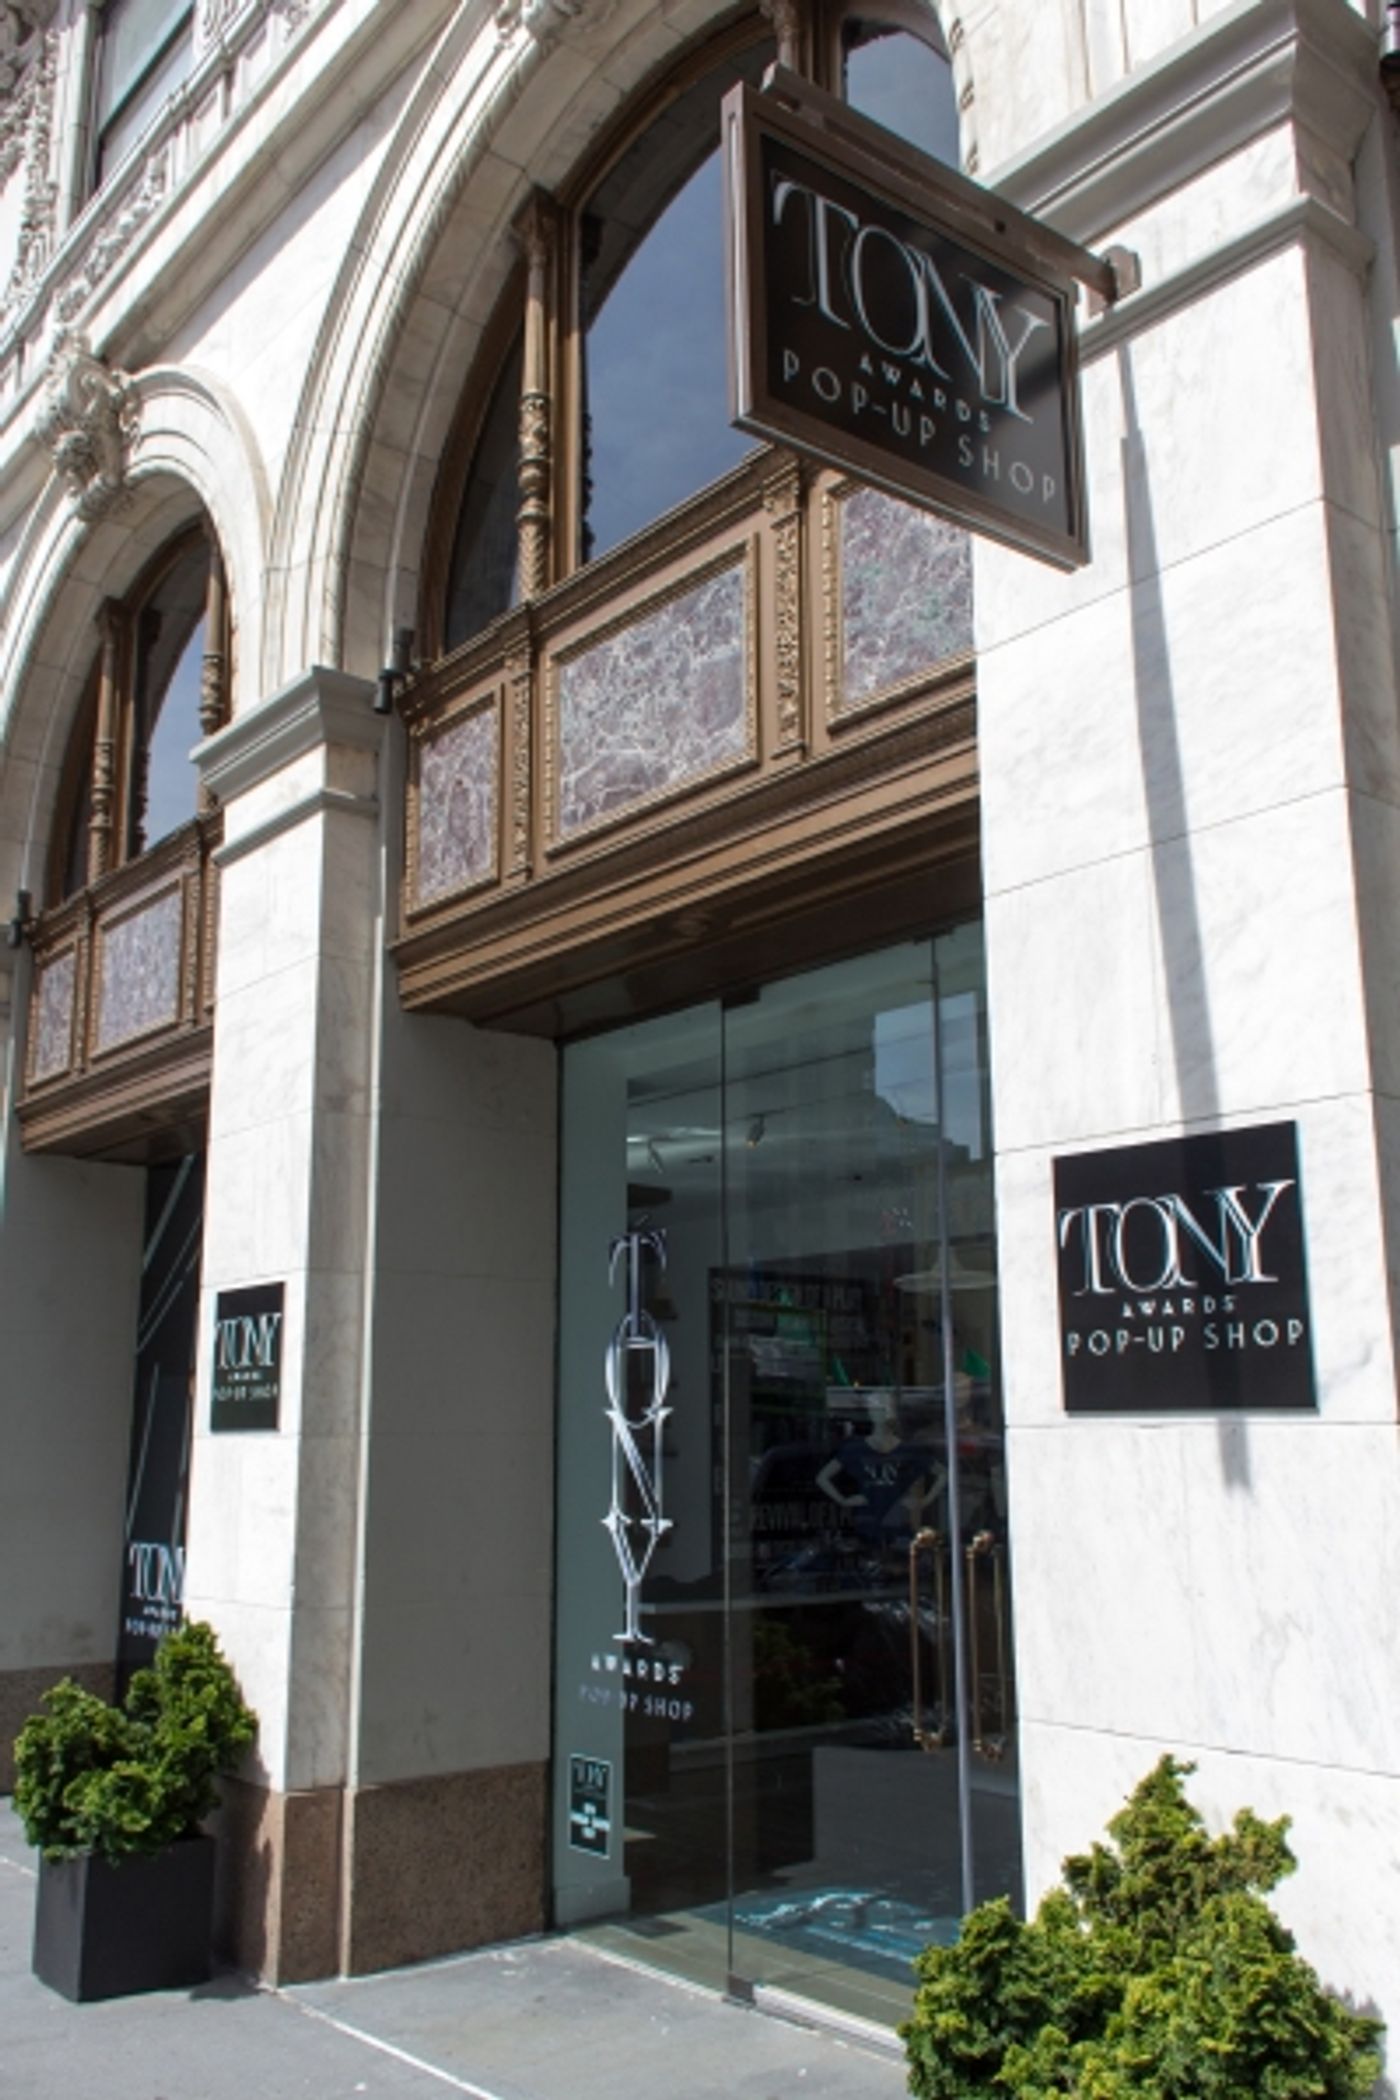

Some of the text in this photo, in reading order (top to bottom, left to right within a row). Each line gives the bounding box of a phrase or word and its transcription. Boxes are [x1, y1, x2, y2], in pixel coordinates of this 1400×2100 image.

[771, 174, 1050, 424] TONY
[782, 348, 1056, 502] POP-UP SHOP
[860, 352, 991, 433] AWARDS
[1058, 1179, 1296, 1296] TONY
[215, 1311, 282, 1370] TONY
[1067, 1318, 1304, 1356] POP-UP SHOP
[1122, 1295, 1237, 1319] AWARDS
[603, 1229, 674, 1646] TONY
[590, 1653, 684, 1685] AWARDS
[643, 1695, 694, 1722] SHOP
